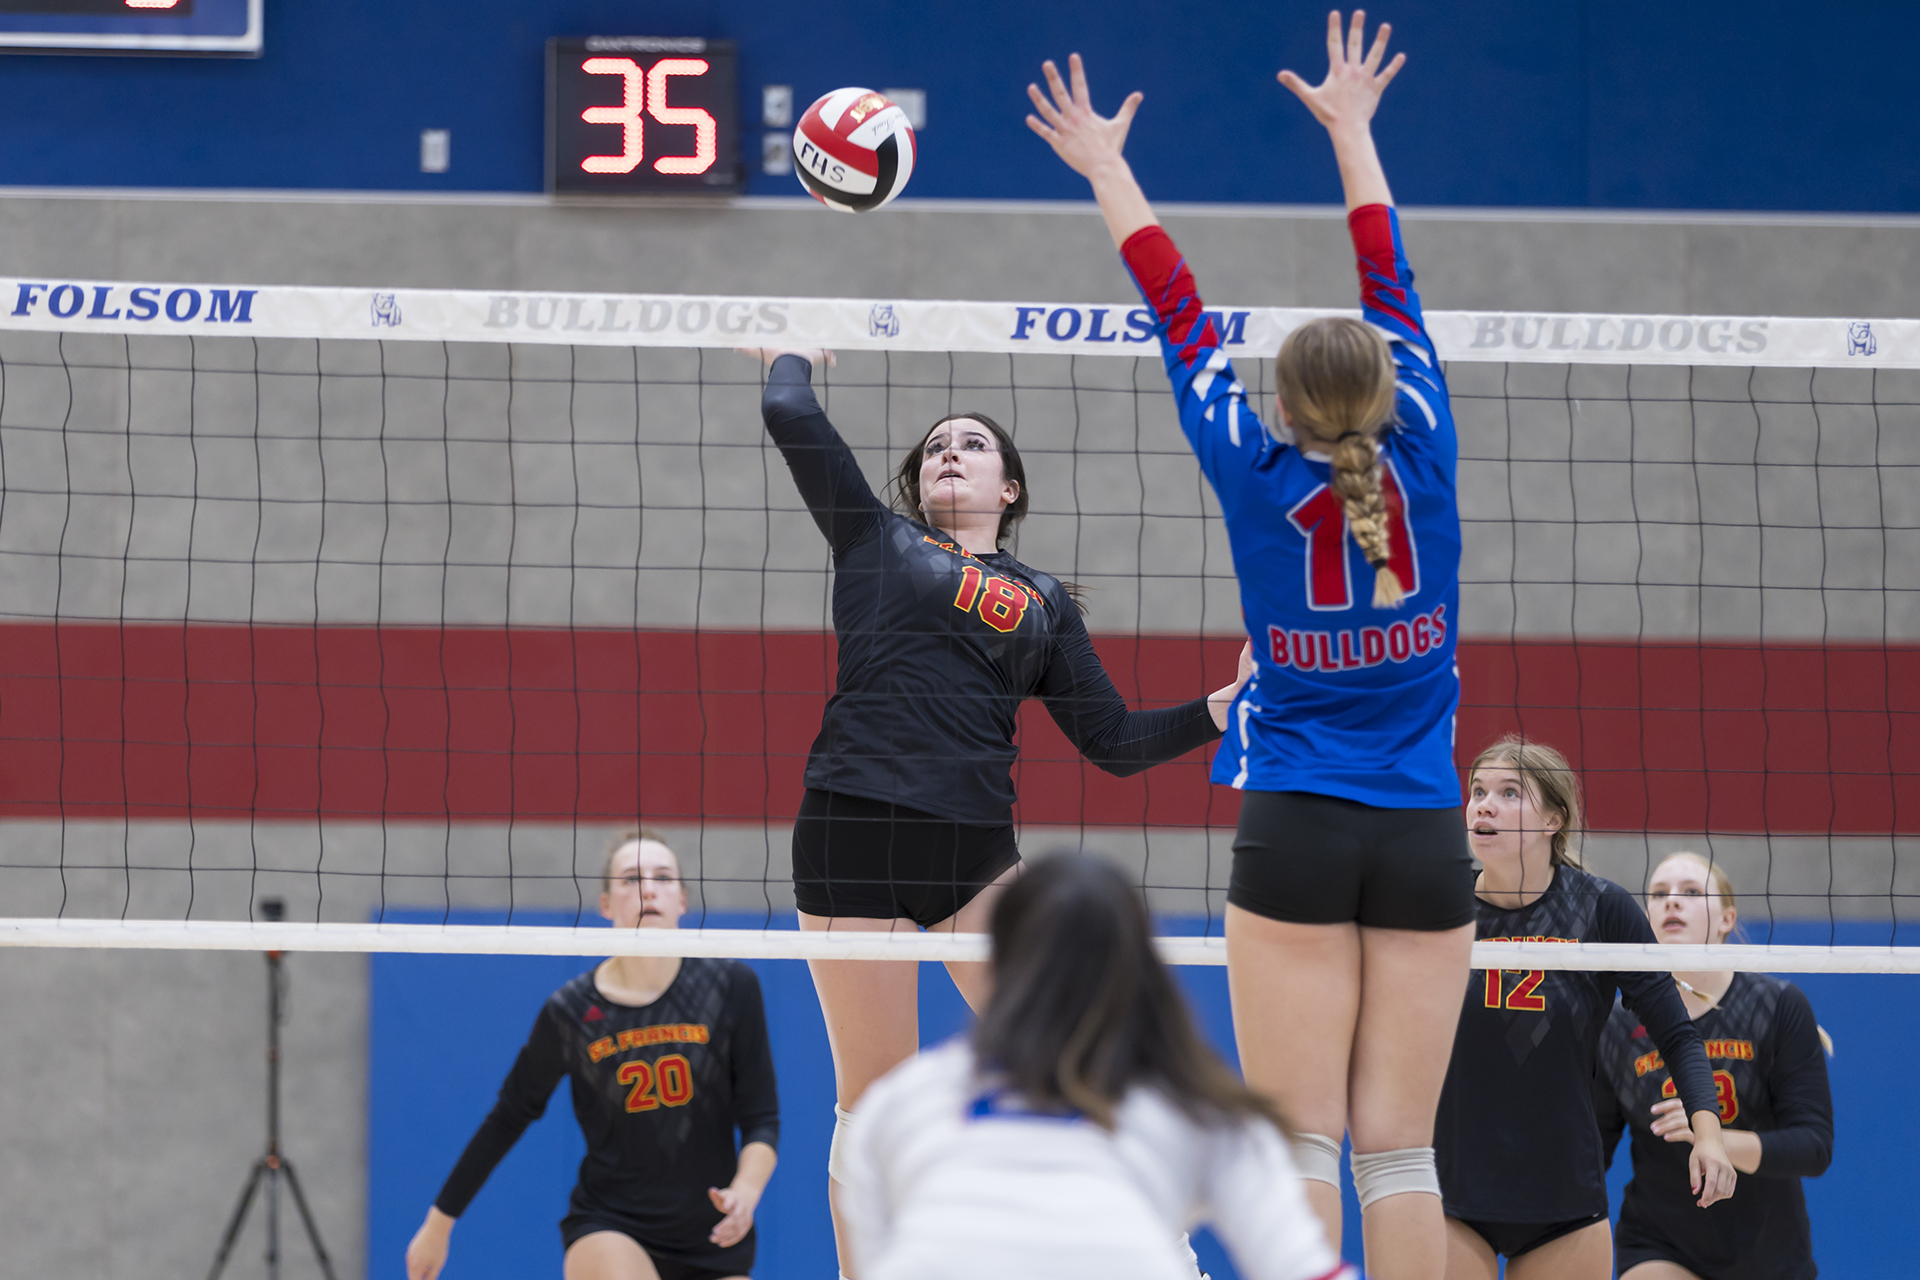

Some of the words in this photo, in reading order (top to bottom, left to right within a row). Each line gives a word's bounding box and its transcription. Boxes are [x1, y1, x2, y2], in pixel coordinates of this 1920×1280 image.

[580, 57, 717, 174] 35
[801, 142, 846, 184] FHS
[11, 283, 258, 323] FOLSOM
[483, 295, 790, 335] BULLDOGS
[1010, 306, 1250, 345] FOLSM
[1470, 315, 1769, 355] BULLDOGS
[953, 565, 1029, 633] 18
[1268, 603, 1447, 673] BULLDOGS
[1485, 969, 1546, 1011] 12
[587, 1035, 618, 1063] ST.
[616, 1022, 710, 1051] FRANCIS
[1704, 1038, 1754, 1061] NCIS
[616, 1053, 693, 1113] 20
